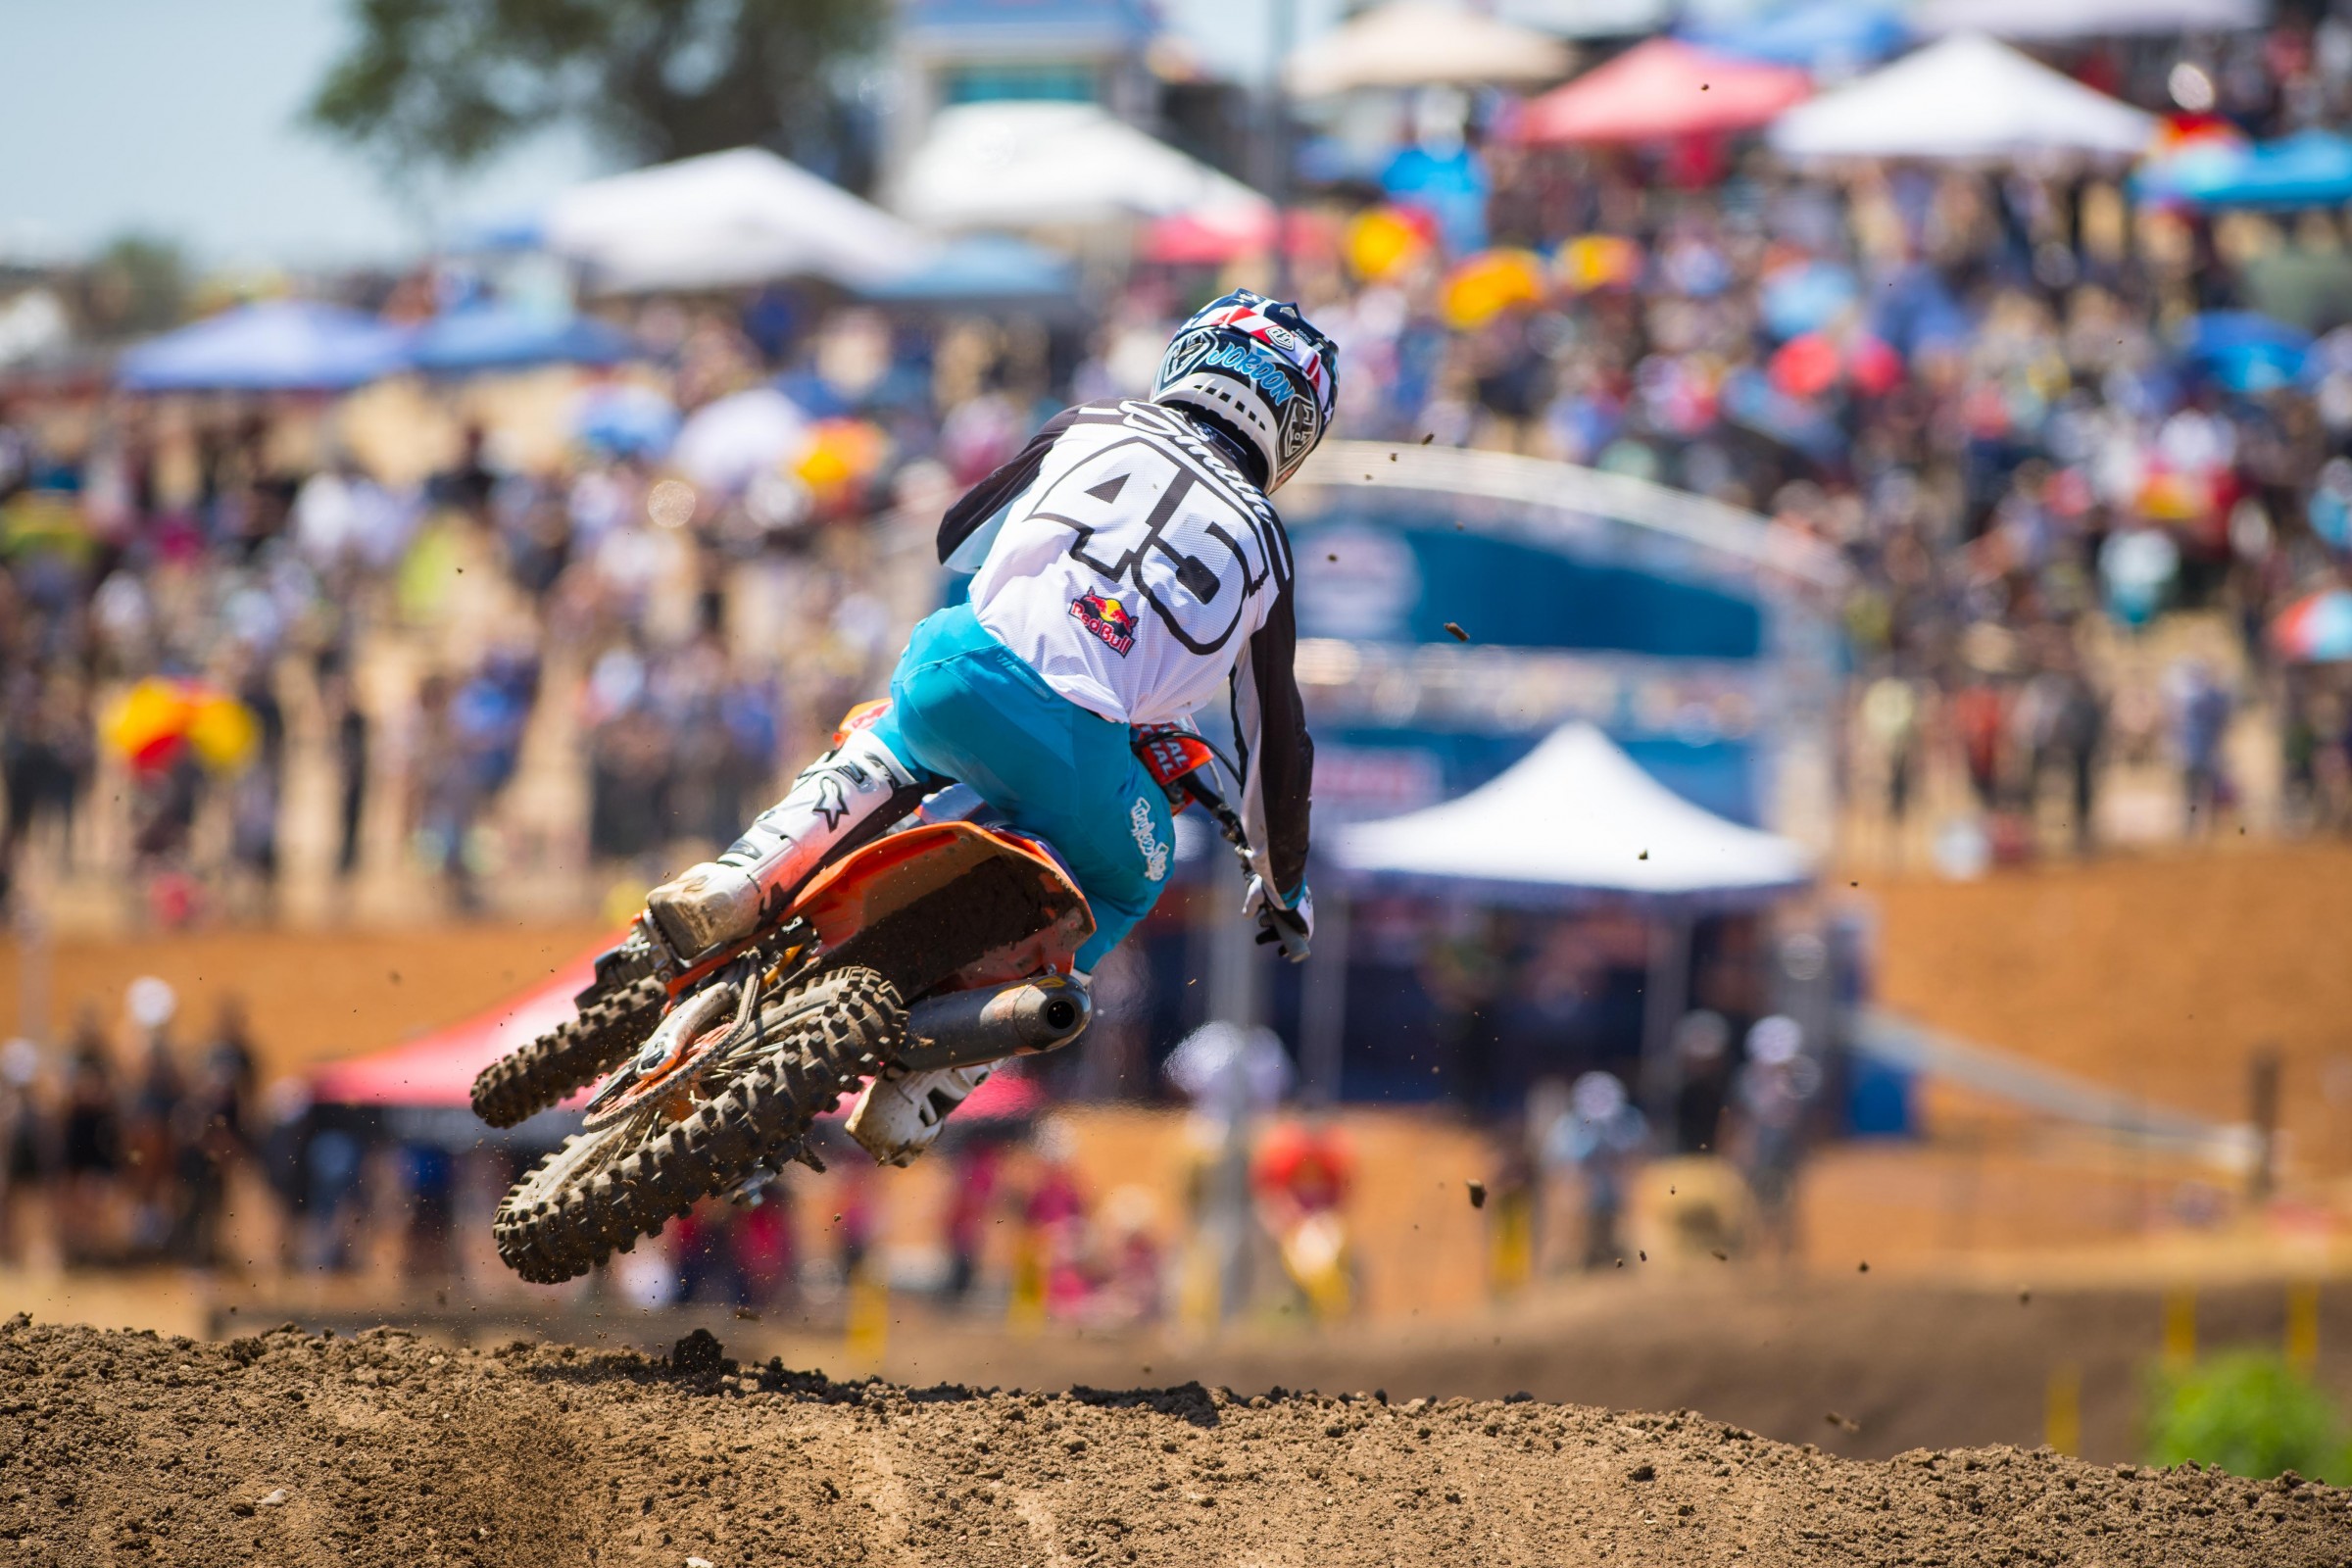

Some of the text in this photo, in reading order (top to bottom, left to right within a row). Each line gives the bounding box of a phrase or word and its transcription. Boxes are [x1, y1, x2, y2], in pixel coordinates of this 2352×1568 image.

[1206, 341, 1296, 407] JORDON
[1119, 400, 1273, 524] Smith
[1022, 435, 1270, 656] 45
